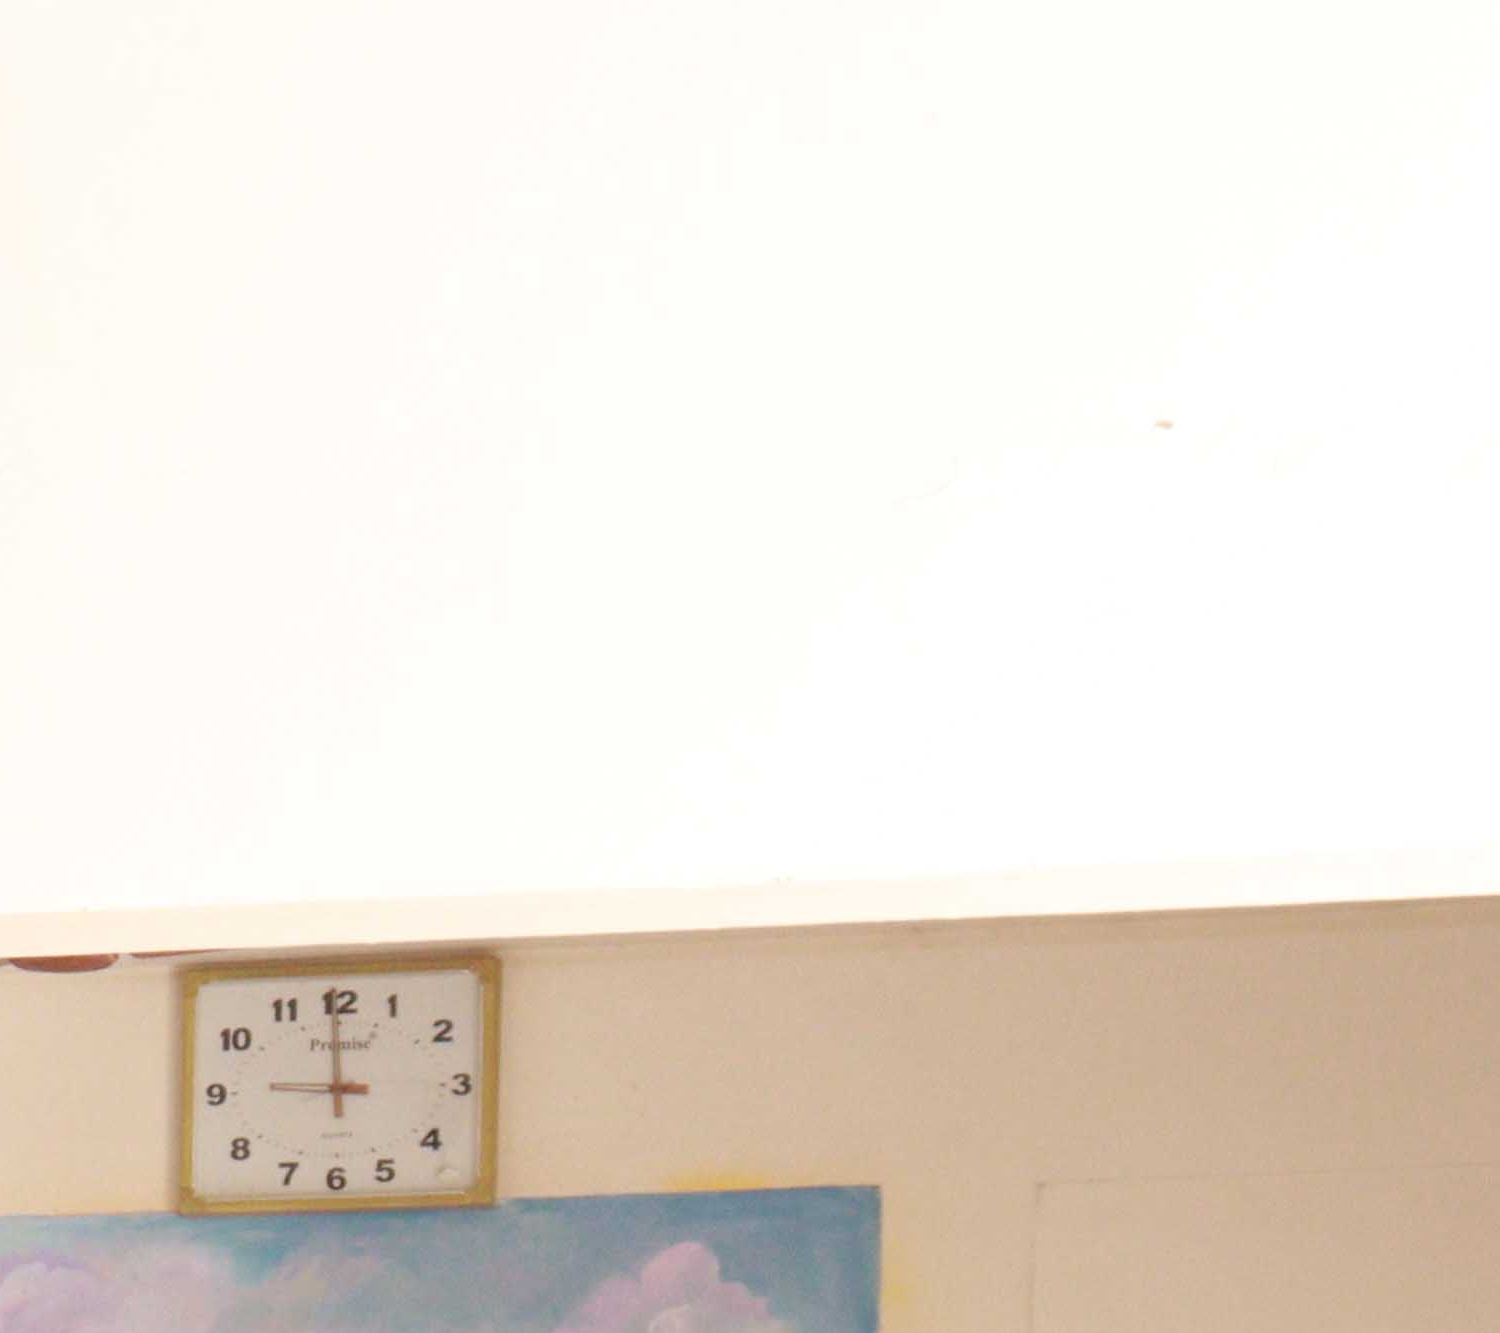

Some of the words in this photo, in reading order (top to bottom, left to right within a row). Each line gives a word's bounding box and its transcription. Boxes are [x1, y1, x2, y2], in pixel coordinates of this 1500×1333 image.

[272, 998, 298, 1022] 11
[323, 990, 358, 1014] 12
[388, 995, 398, 1018] 1
[220, 1027, 251, 1051] 10
[433, 1019, 453, 1043] 2
[206, 1083, 227, 1105] 9
[452, 1073, 471, 1096] 3
[230, 1138, 251, 1161] 8
[420, 1128, 441, 1150] 4
[279, 1162, 298, 1185] 7
[326, 1168, 346, 1190] 6
[375, 1159, 395, 1182] 5
